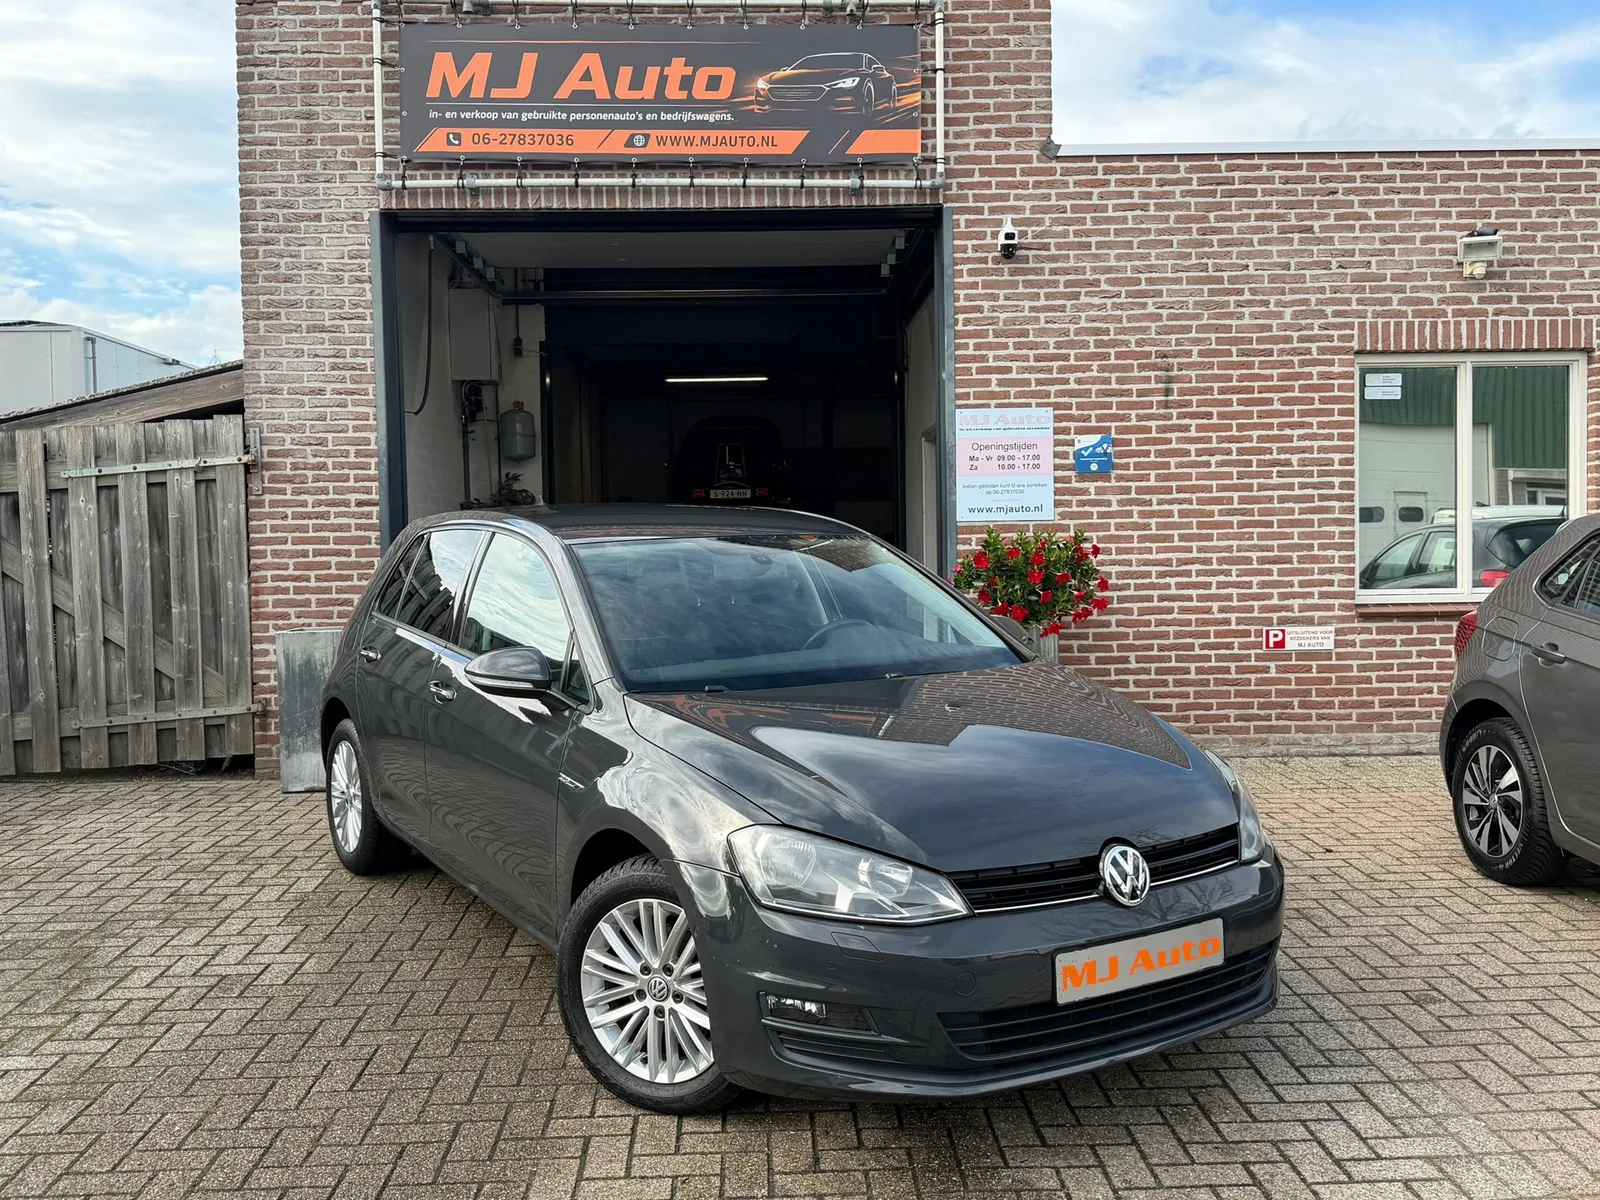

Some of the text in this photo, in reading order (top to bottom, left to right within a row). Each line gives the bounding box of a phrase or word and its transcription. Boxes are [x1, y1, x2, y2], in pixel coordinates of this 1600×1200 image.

[426, 52, 736, 100] MJ Auto
[429, 109, 735, 122] in- en verkoop van gebruikte personenauto's en bedrijfswagens.
[471, 132, 575, 146] 06-27837036
[656, 135, 778, 148] WWW.MJAUTO.NL
[959, 414, 1051, 426] MJ Auto
[971, 442, 1038, 452] Openingstijden
[968, 504, 1043, 515] www.mjauto.nl
[1269, 630, 1283, 648] P
[1062, 937, 1221, 992] MJ Auto
